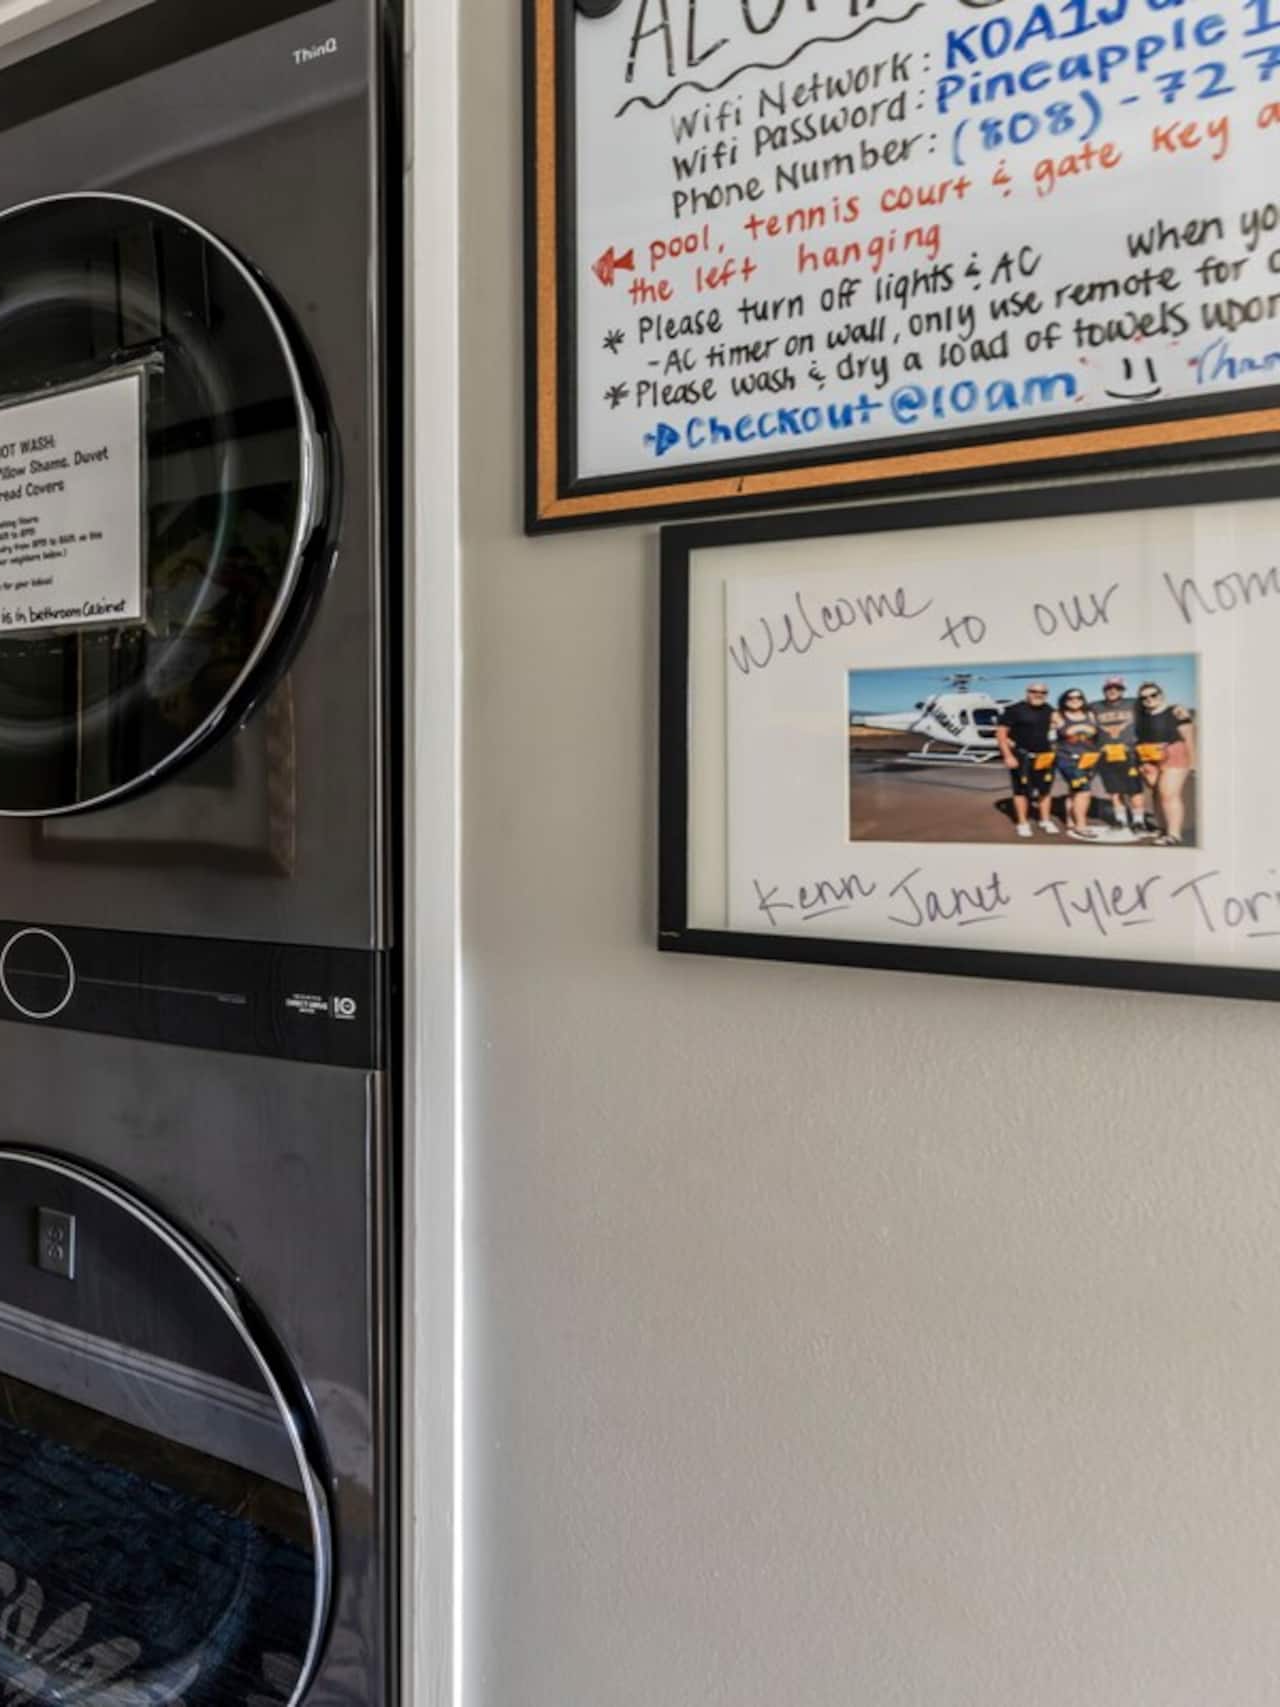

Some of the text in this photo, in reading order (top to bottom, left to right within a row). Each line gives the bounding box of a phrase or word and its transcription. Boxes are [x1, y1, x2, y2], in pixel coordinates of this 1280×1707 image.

[292, 37, 337, 65] ThinQ
[671, 95, 742, 145] Wifi
[672, 137, 738, 181] Wifi
[672, 177, 765, 219] Phone
[744, 195, 861, 241] tennis
[880, 175, 972, 213] court
[1033, 140, 1122, 198] gate
[628, 224, 941, 305] the left hanging
[638, 308, 723, 344] Please
[738, 295, 804, 324] turn
[820, 277, 861, 312] off
[875, 264, 954, 310] lights
[991, 245, 1042, 285] AC
[1128, 215, 1224, 258] when
[705, 336, 779, 369] timer
[785, 333, 814, 357] on
[908, 304, 975, 342] only
[990, 290, 1042, 321] use
[1055, 266, 1181, 309] remote
[1195, 256, 1250, 286] for
[635, 378, 717, 408] Please
[731, 366, 796, 397] wash
[836, 353, 889, 388] dry
[904, 352, 922, 371] a
[939, 331, 1008, 368] load
[1026, 322, 1061, 352] of
[1073, 301, 1189, 348] towels
[20, 434, 55, 455] WASH
[74, 446, 109, 466] Duvet
[25, 480, 64, 497] Covers
[1, 607, 13, 625] is
[15, 607, 27, 625] in
[728, 585, 934, 676] Welcome
[940, 614, 986, 650] to
[1034, 583, 1120, 639] our
[753, 872, 876, 927] Kenn
[889, 869, 1011, 928] Janet
[1034, 875, 1162, 935] Tyler
